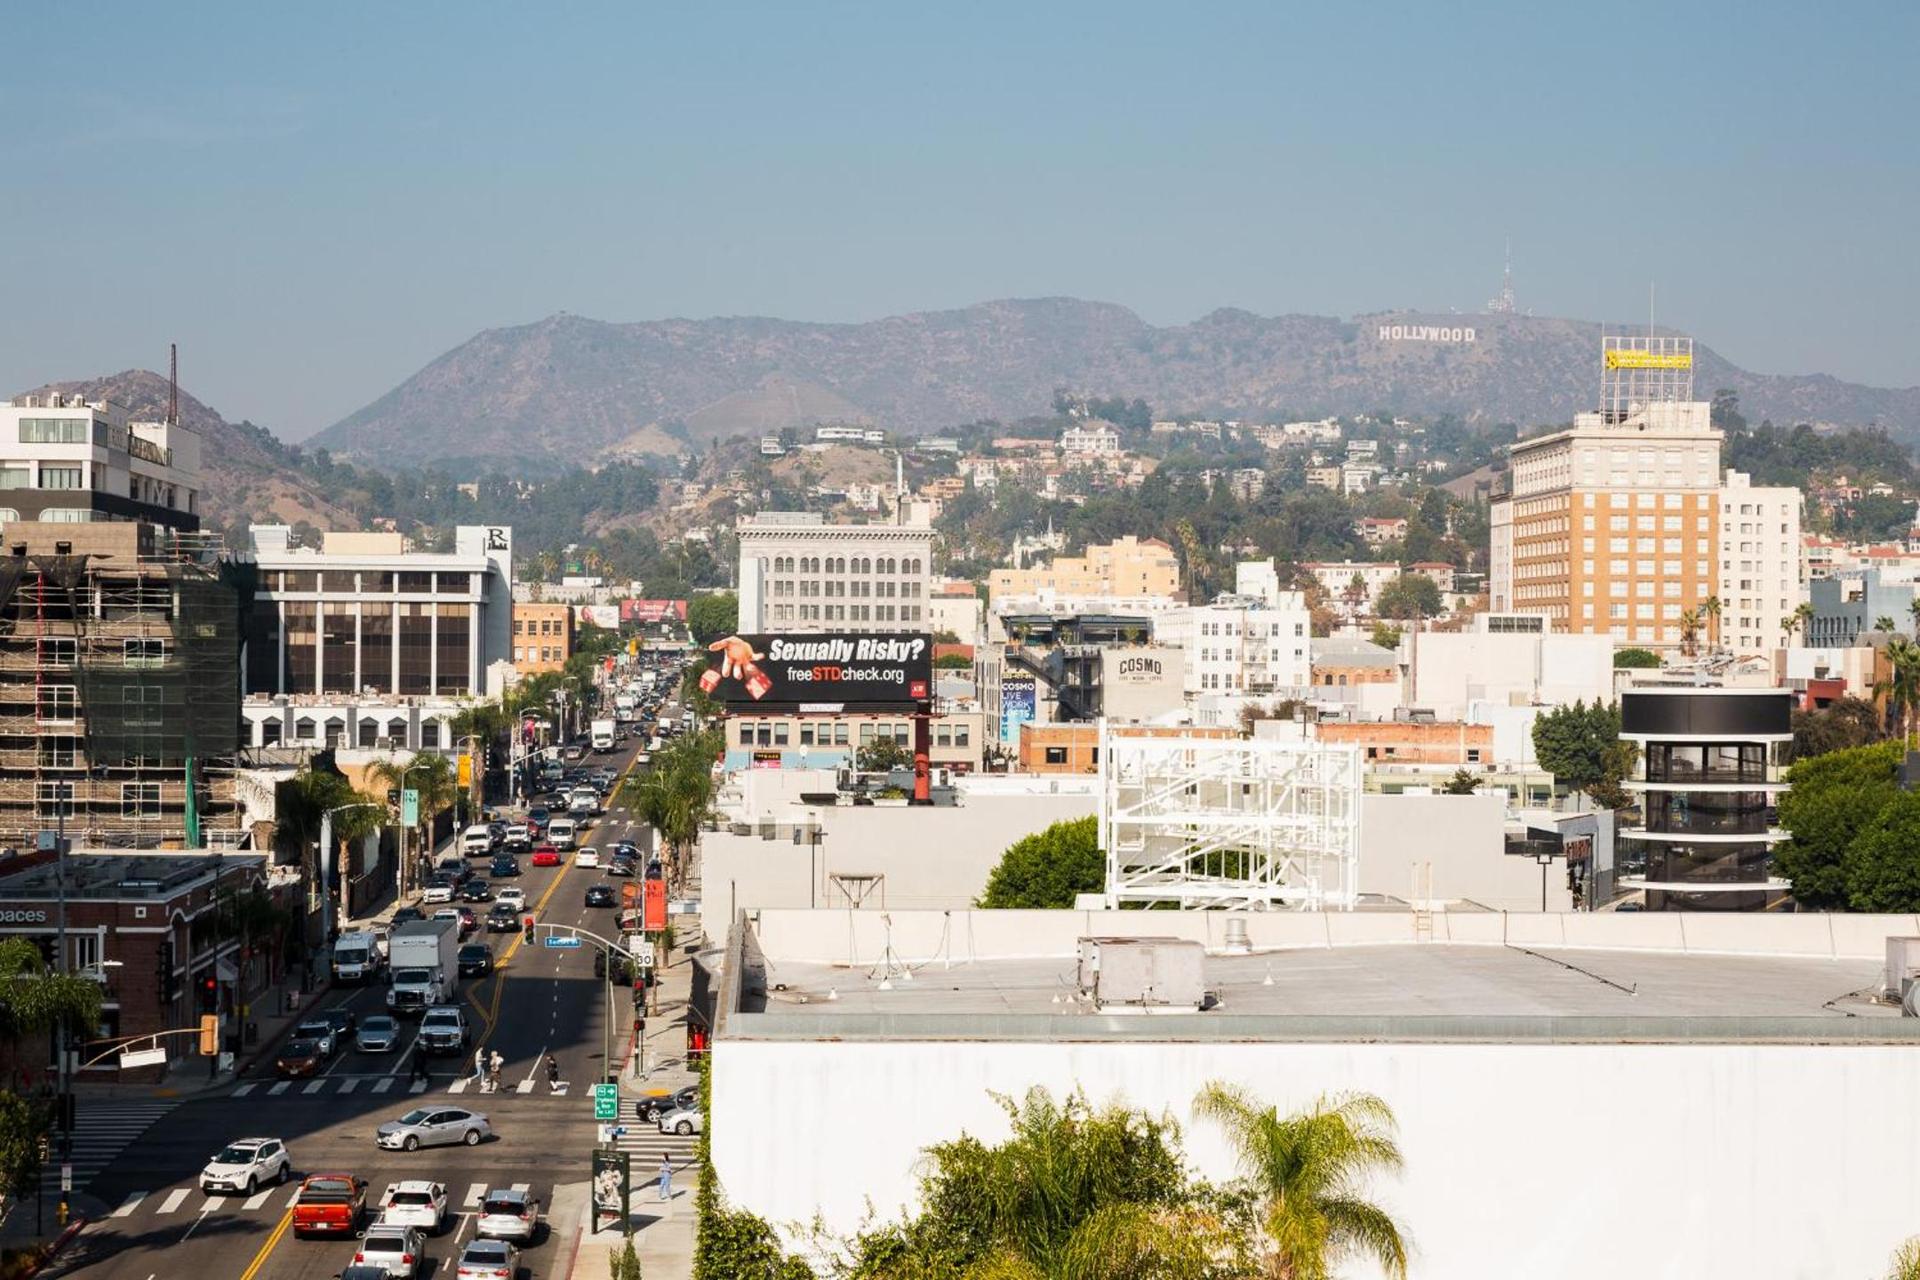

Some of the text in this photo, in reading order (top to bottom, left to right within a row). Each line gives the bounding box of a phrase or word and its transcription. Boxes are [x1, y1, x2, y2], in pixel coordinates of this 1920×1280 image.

[1379, 325, 1475, 341] HOLLYWOOD
[769, 638, 925, 662] Sexually Risky?
[1120, 657, 1162, 674] COSMO
[787, 666, 904, 684] freeSTDcheck.org
[1002, 682, 1035, 691] COSMO
[1002, 691, 1022, 700] LIVE
[638, 956, 651, 965] 30
